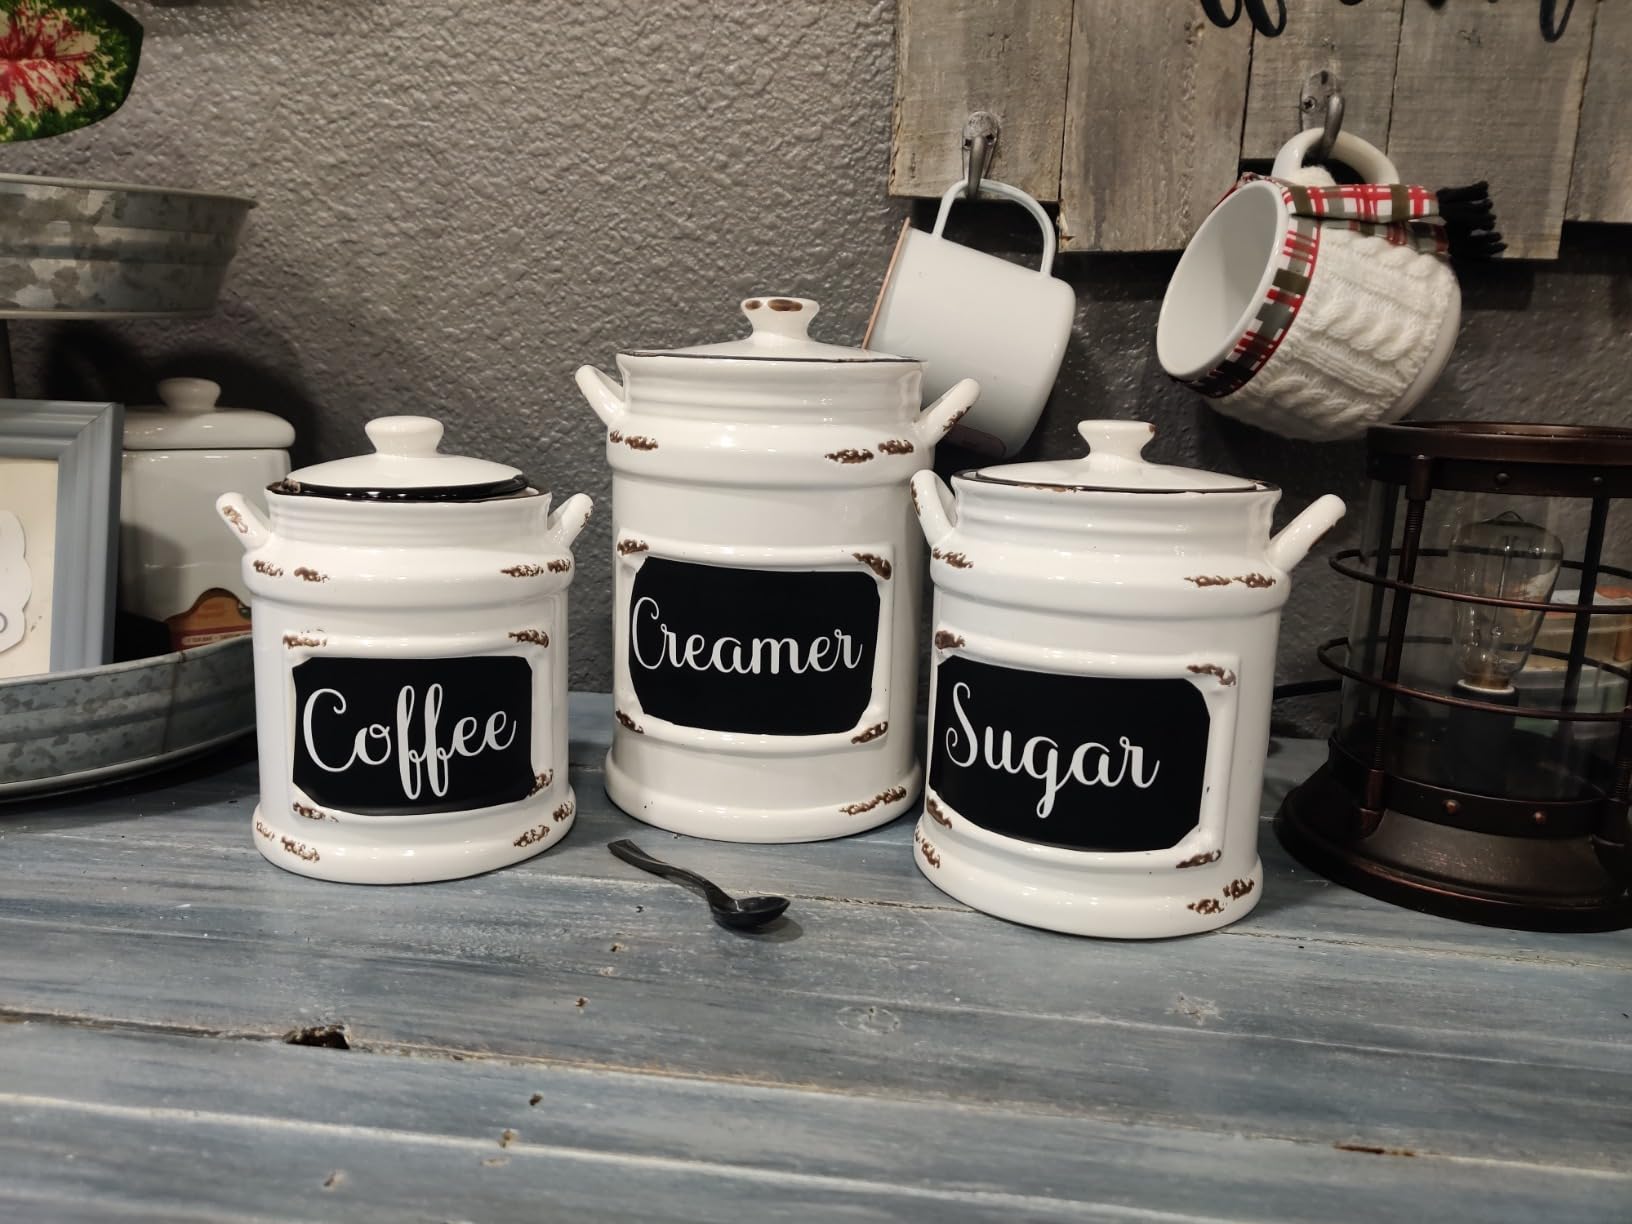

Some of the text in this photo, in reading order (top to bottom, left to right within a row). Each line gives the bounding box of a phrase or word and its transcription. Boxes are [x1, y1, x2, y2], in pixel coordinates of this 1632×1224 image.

[632, 596, 863, 675] Creamer
[303, 683, 517, 800] Coffee
[945, 682, 1160, 819] Sugar
